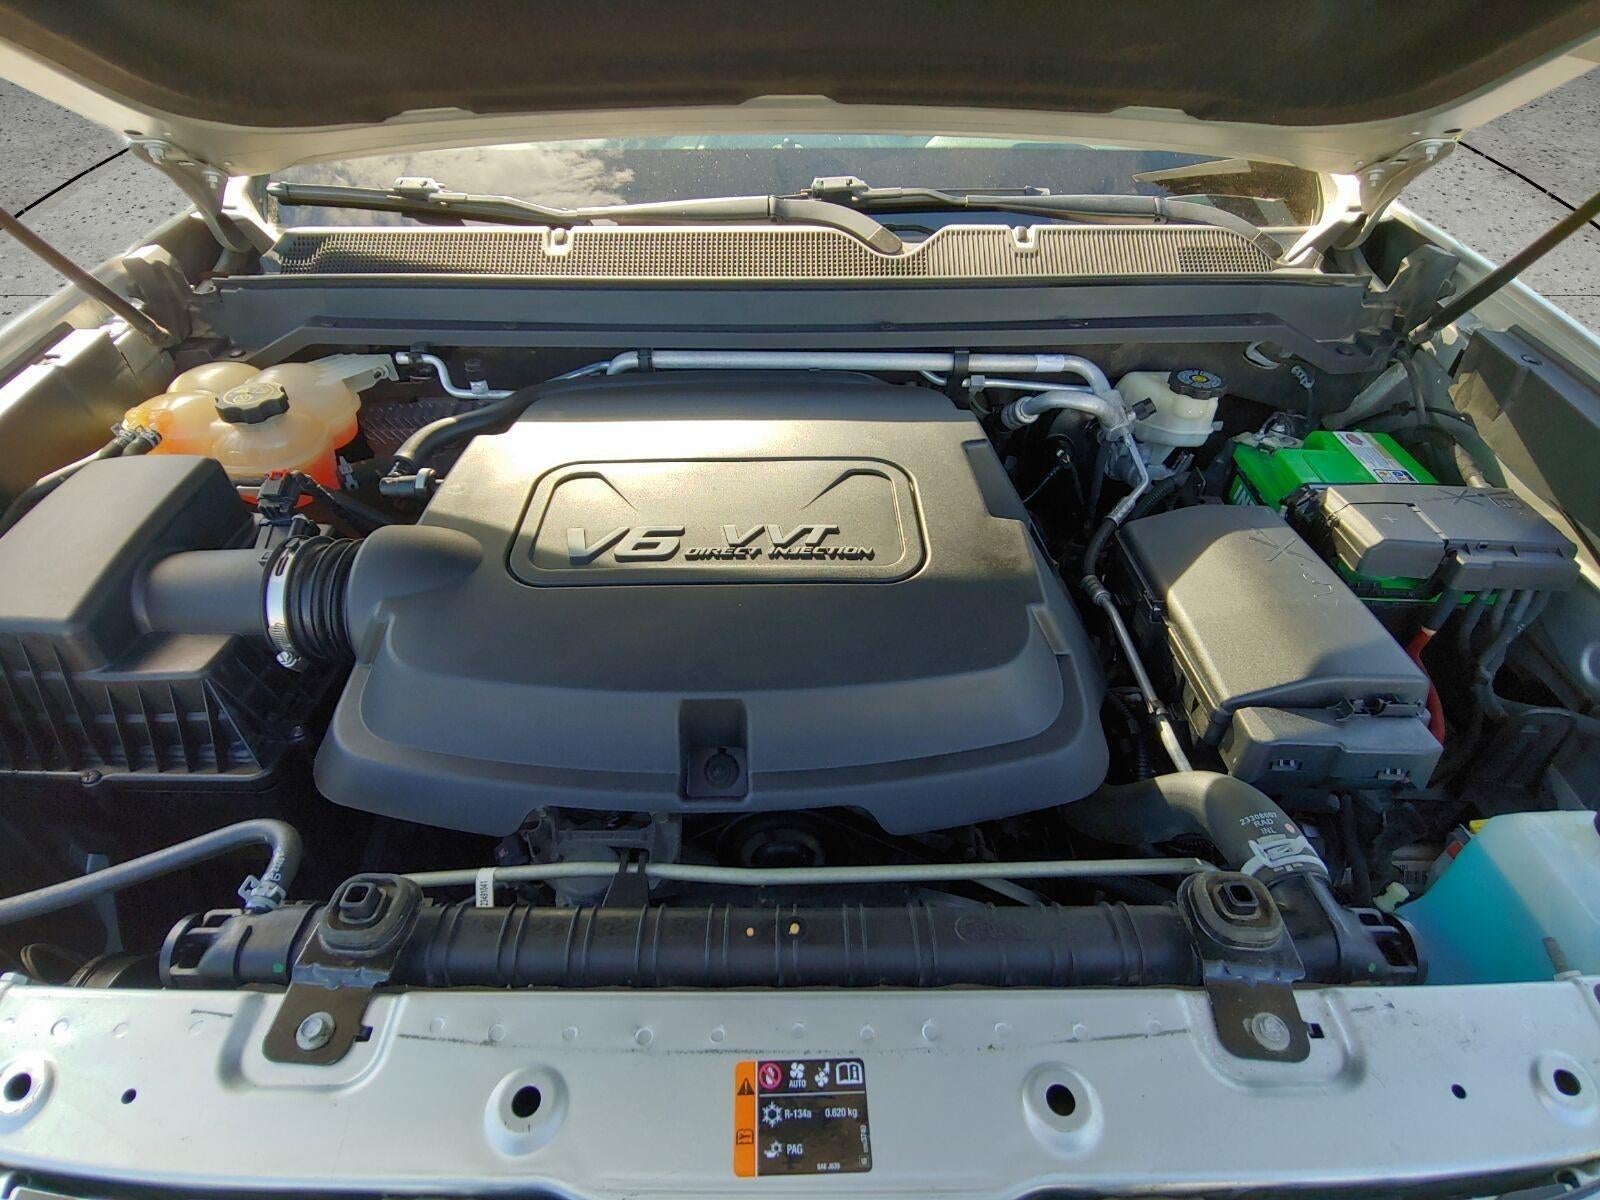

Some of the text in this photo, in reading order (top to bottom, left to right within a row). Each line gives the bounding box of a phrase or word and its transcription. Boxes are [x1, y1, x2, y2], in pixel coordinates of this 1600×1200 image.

[722, 524, 840, 548] VVT
[566, 525, 686, 565] V6
[684, 546, 876, 561] DIRECT INJECTION
[1254, 818, 1273, 828] RAD
[788, 1080, 806, 1088] AUTO
[784, 1107, 858, 1118] R-134a 0.620 kg
[786, 1144, 803, 1154] PAG
